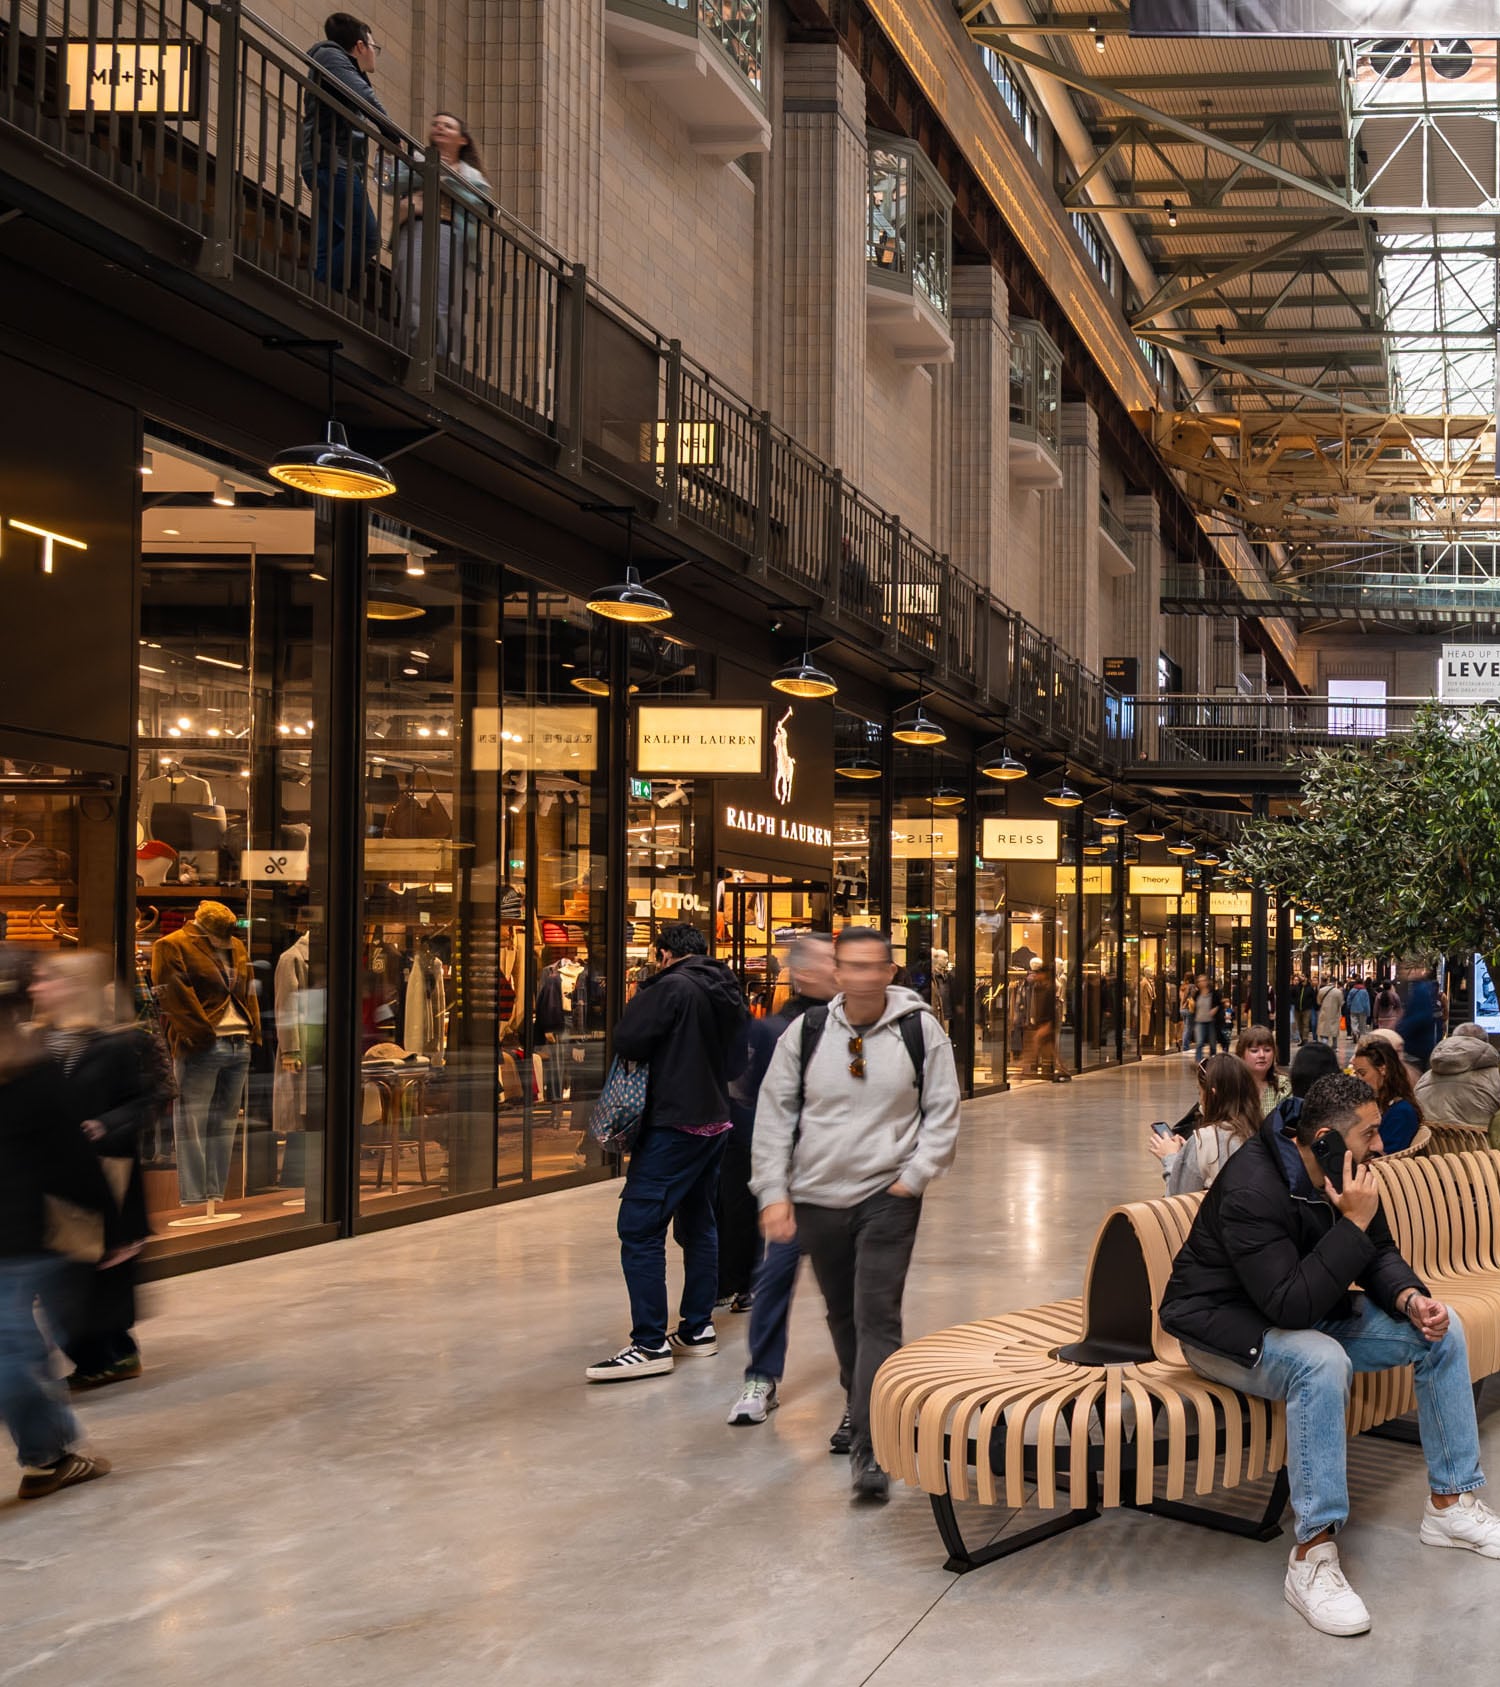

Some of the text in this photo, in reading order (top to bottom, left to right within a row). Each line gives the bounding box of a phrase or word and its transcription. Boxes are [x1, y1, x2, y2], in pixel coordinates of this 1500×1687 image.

[1447, 651, 1475, 659] HEAD
[1480, 651, 1491, 659] UP
[643, 735, 756, 745] RALPH LAUREN
[727, 806, 831, 847] RALPH LAUREN
[998, 834, 1044, 844] REISS
[1142, 876, 1169, 884] Theory
